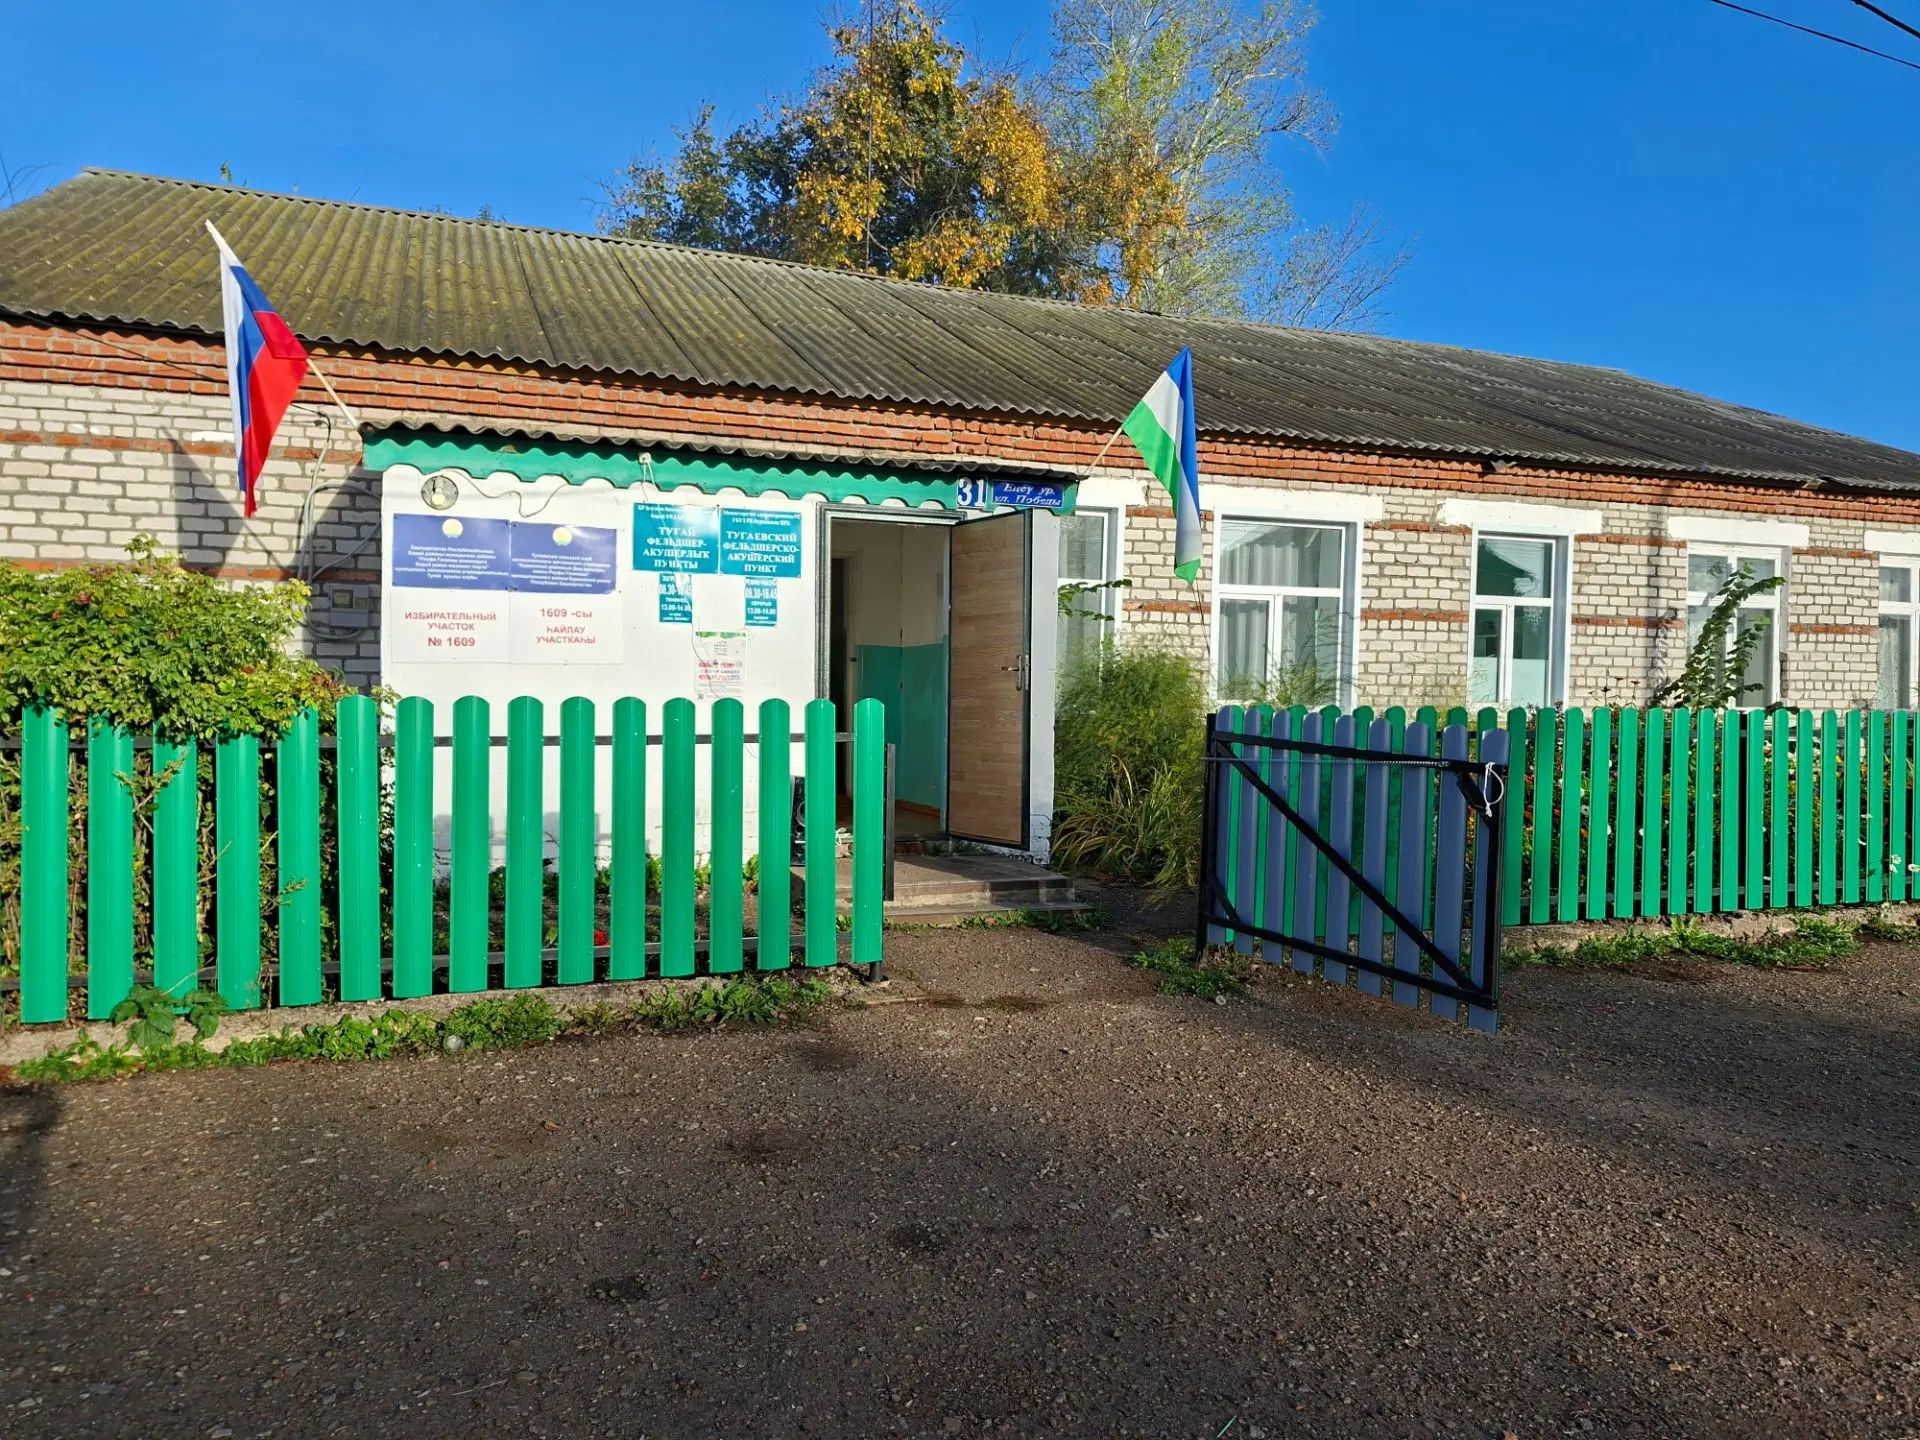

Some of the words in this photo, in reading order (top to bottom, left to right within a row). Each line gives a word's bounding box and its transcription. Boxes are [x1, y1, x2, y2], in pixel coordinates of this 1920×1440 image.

[957, 476, 985, 507] 31
[1015, 494, 1062, 506] Победы
[657, 526, 697, 537] ТУГАЙ
[726, 530, 797, 542] ТУГАЕВСКИЙ
[646, 537, 708, 548] ФЕЛЬДШЕР-
[722, 542, 800, 553] ФЕЛЬДШЕРСКО-
[727, 552, 795, 564] АКУШЕРСКИЙ
[654, 559, 699, 569] ПУНКТЫ
[744, 563, 778, 573] ПУНКТ
[404, 611, 497, 621] ИЗБИРАТЕЛЬНЫЙ
[539, 608, 568, 618] 1609
[571, 609, 593, 619] -сы
[427, 622, 476, 632] УЧАСТОК
[427, 636, 442, 647] №
[448, 637, 476, 647] 1609
